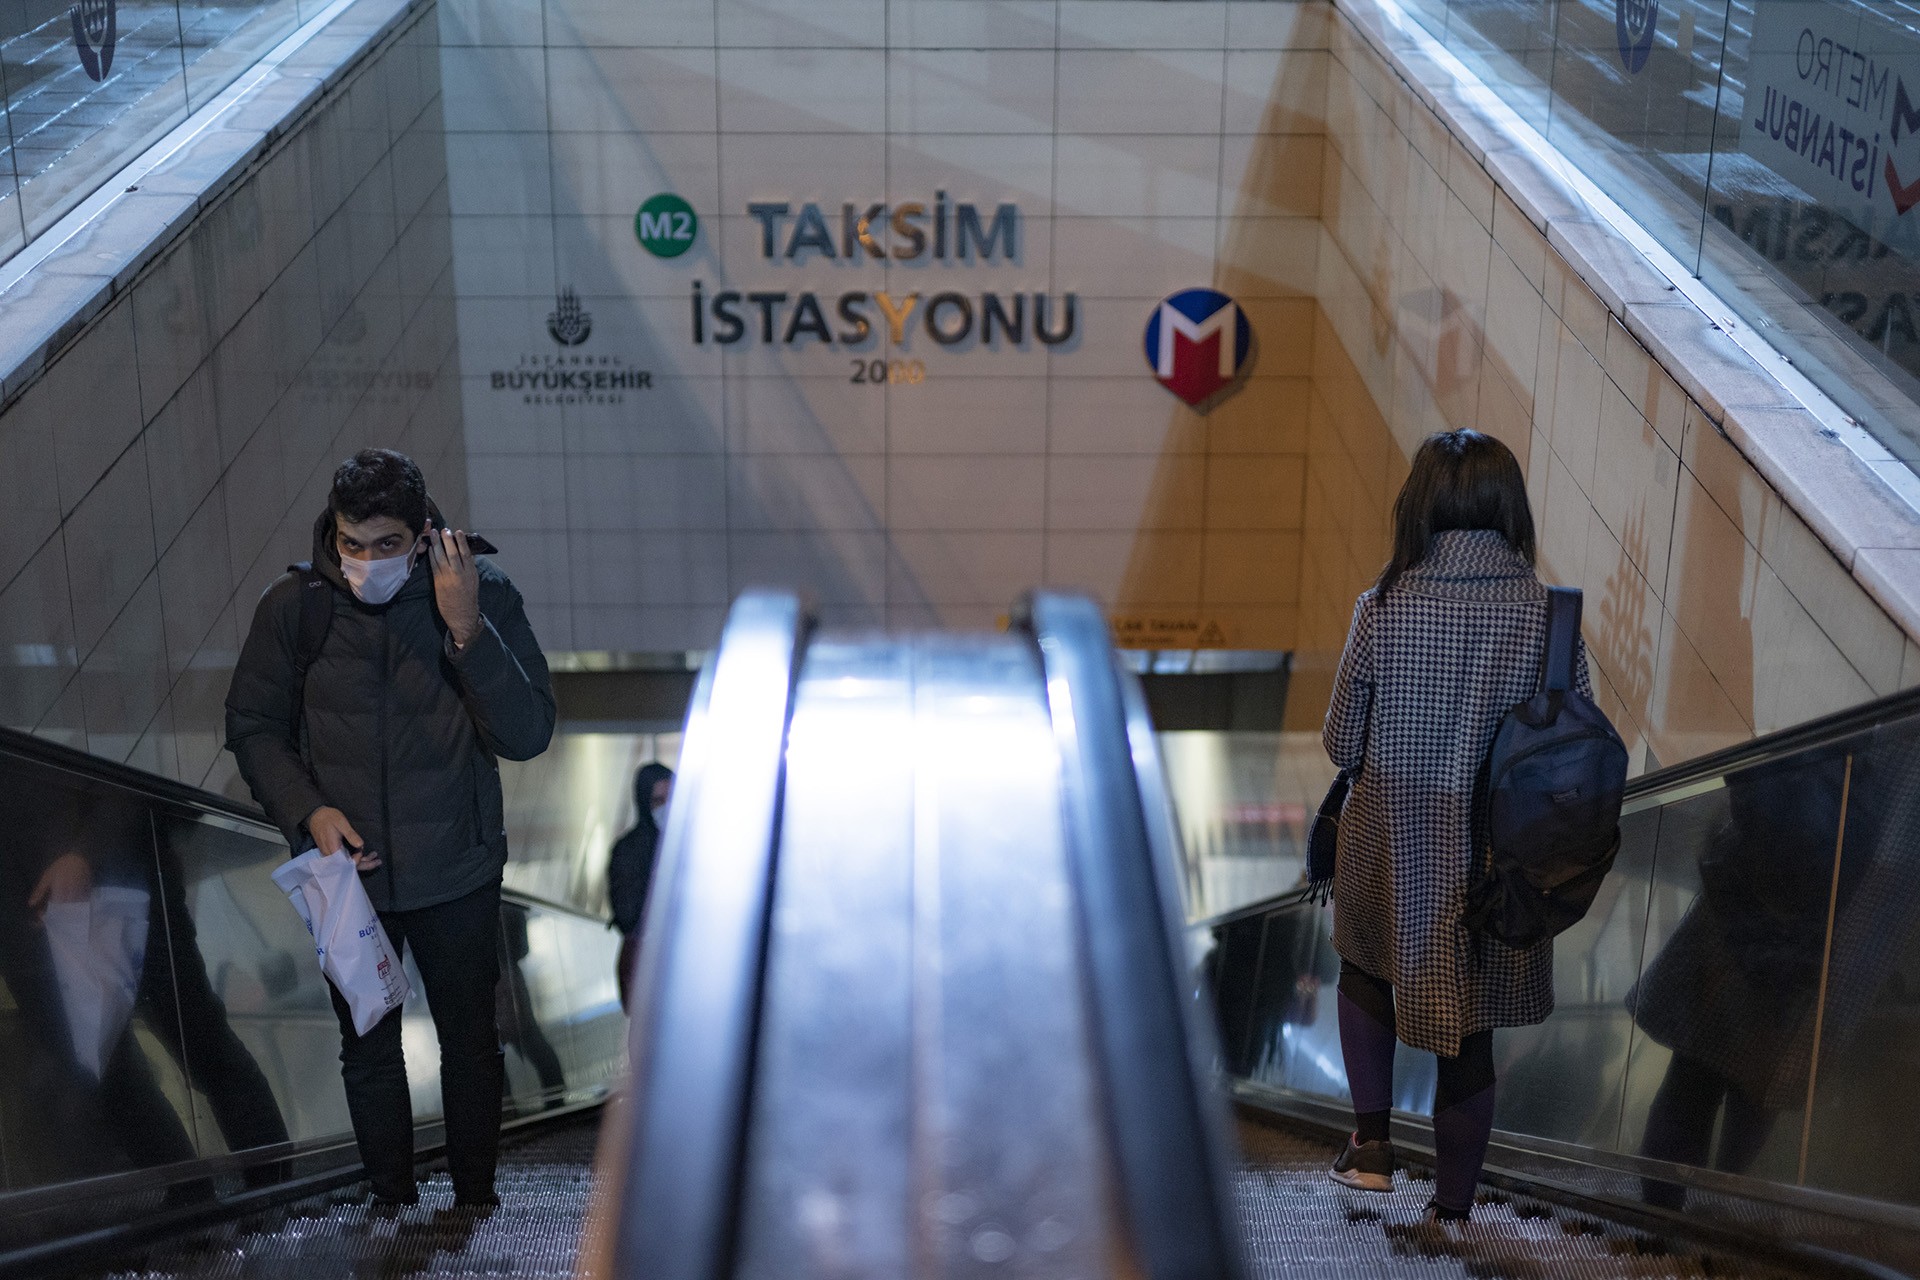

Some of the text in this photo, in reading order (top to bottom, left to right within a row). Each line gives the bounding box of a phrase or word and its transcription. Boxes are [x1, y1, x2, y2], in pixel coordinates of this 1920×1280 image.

[638, 210, 693, 241] M2
[747, 190, 1017, 259] TAKSİM
[692, 279, 1077, 345] İSTASYONU
[489, 364, 655, 395] BÜYÜKŞEHİR
[850, 358, 927, 386] 2000
